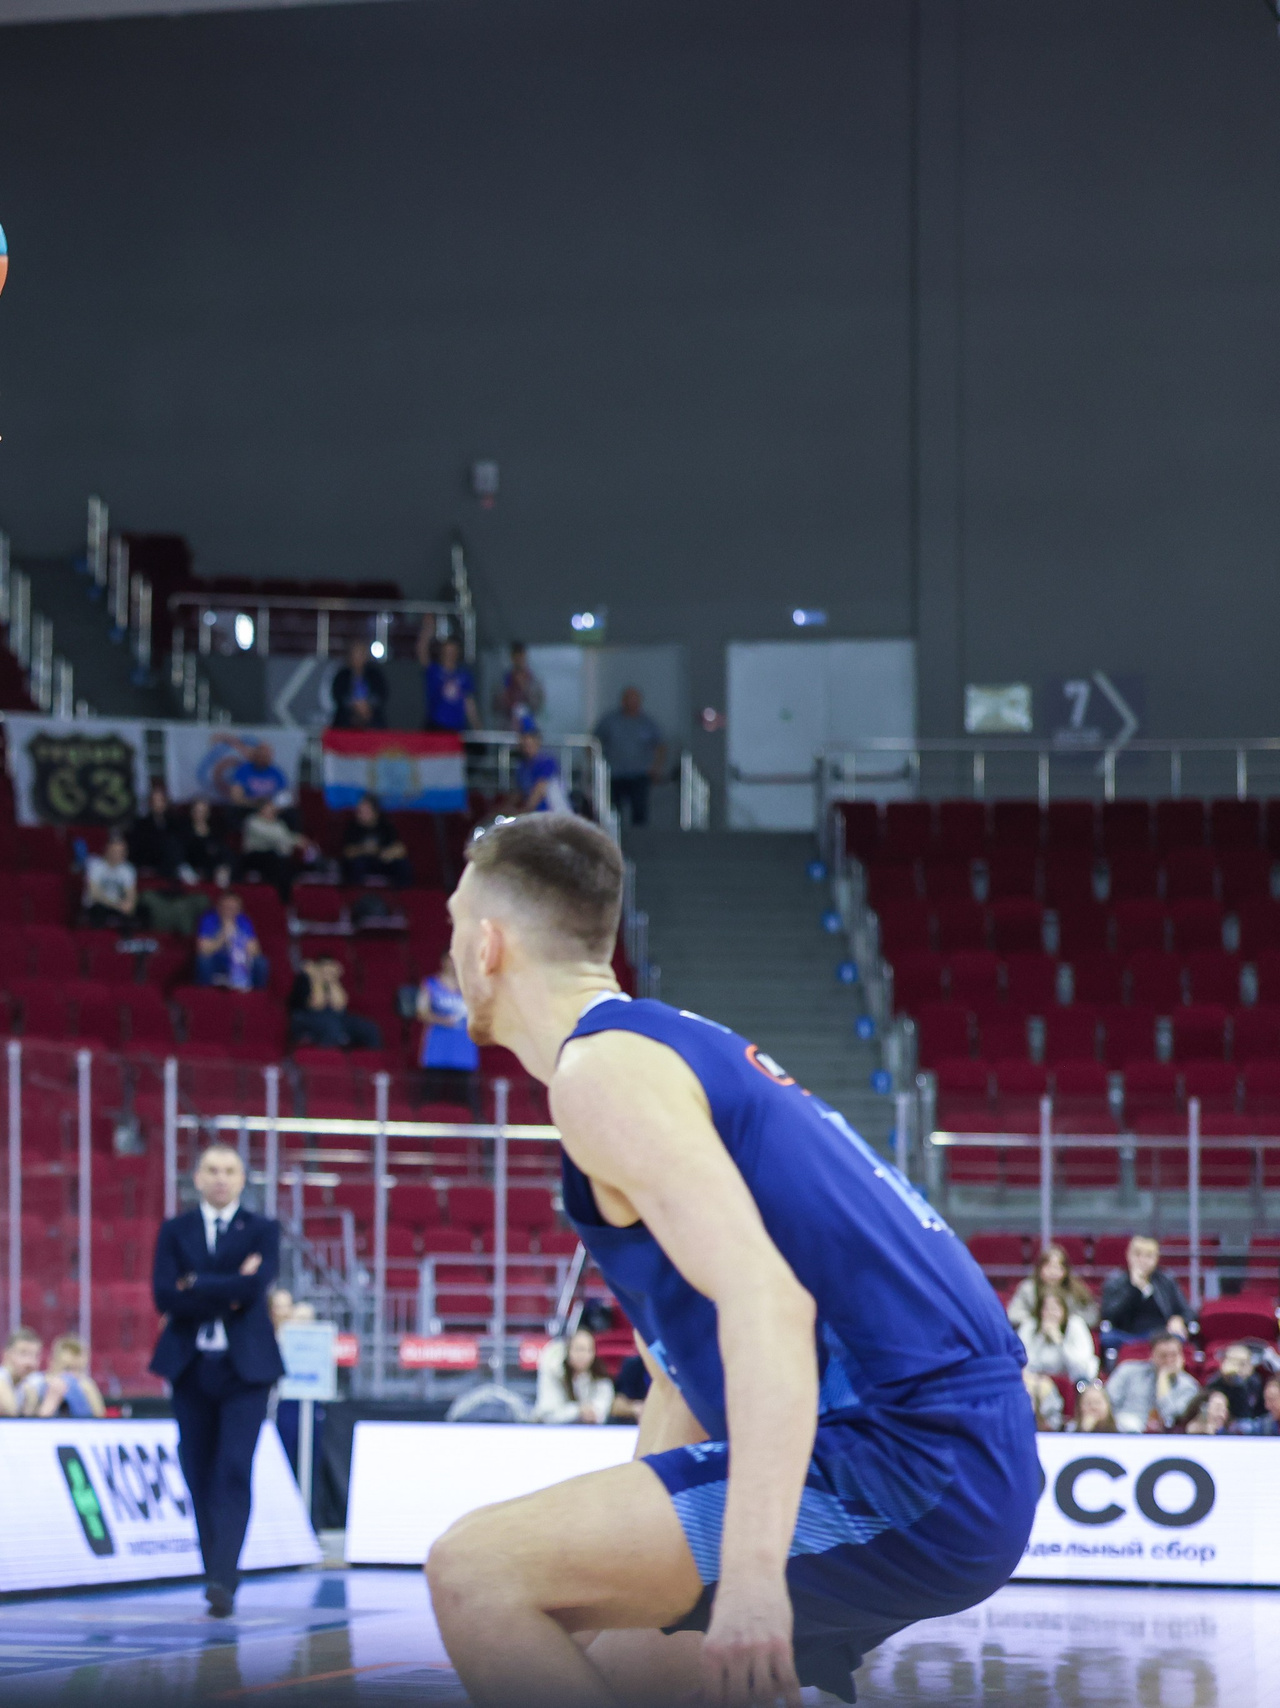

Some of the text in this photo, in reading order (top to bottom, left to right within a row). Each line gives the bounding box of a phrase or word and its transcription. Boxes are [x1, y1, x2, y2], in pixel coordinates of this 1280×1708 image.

[47, 767, 131, 815] 63
[1039, 1456, 1216, 1527] СО
[1025, 1540, 1216, 1566] дельный сбор
